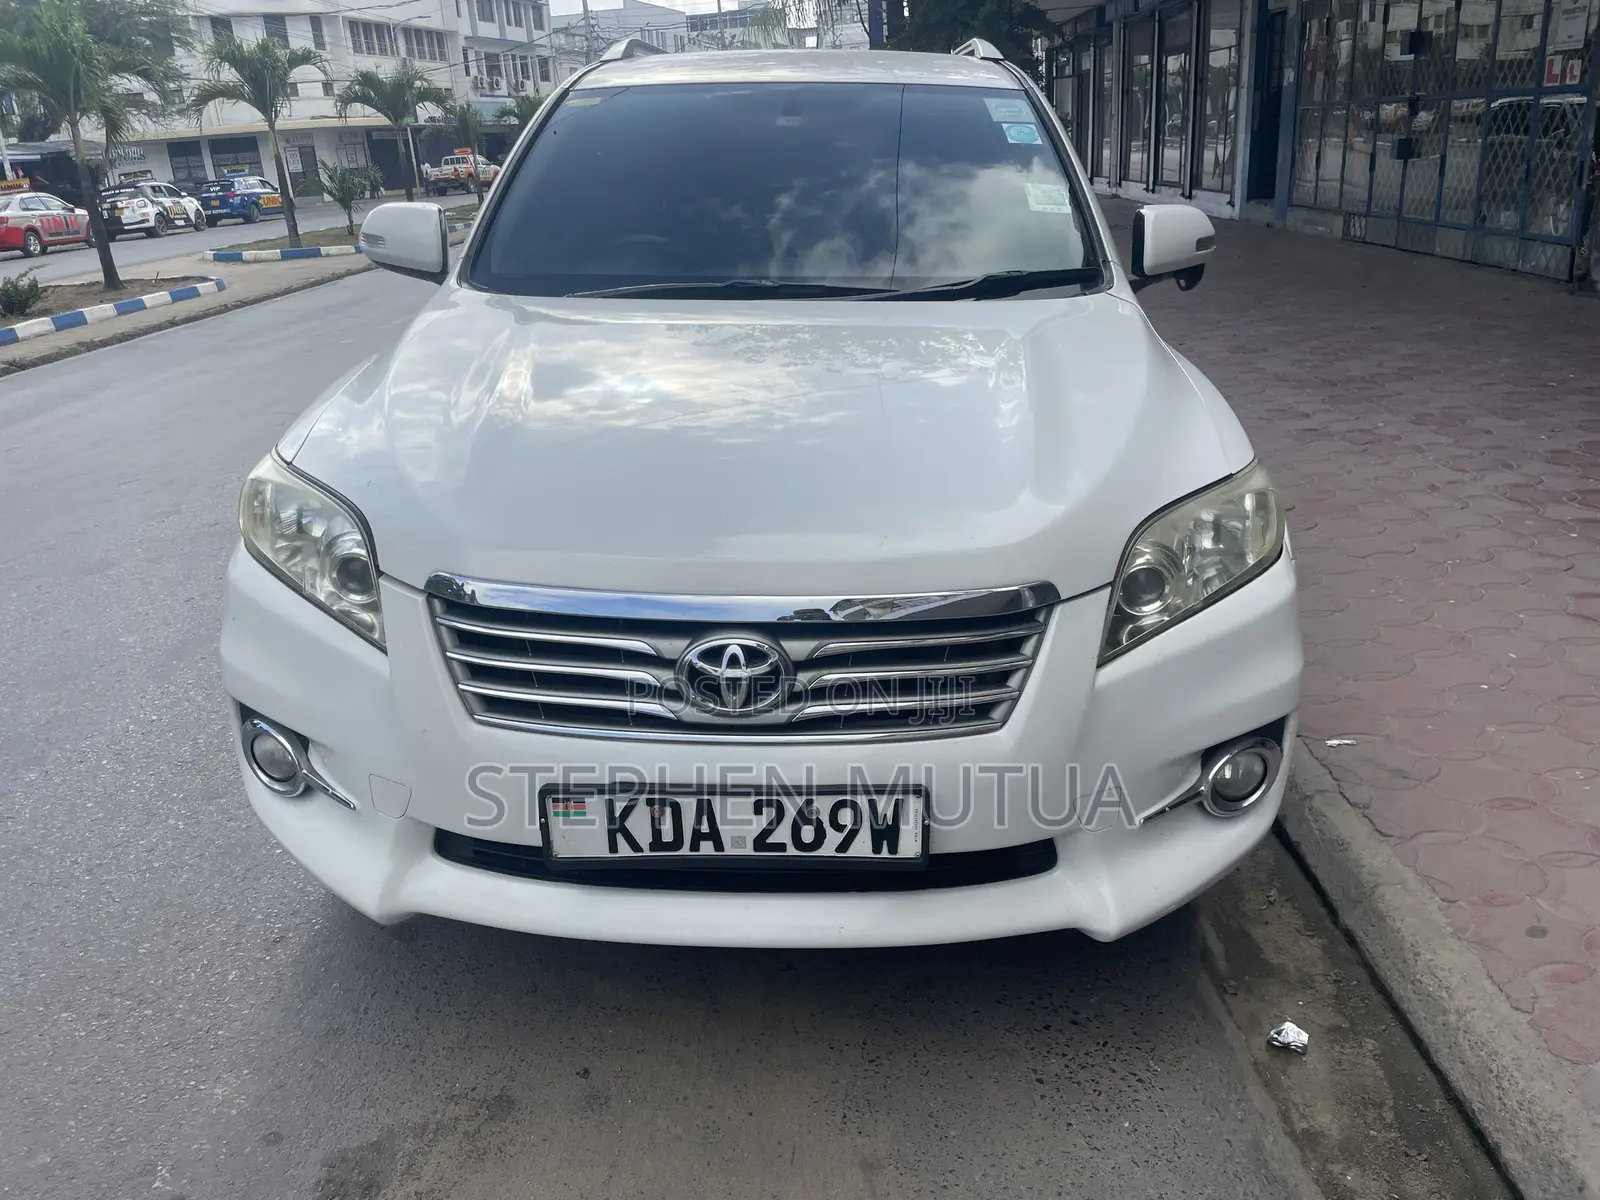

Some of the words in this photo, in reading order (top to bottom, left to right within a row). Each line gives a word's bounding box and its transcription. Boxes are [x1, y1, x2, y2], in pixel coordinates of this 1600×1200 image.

[40, 215, 82, 233] UNIK
[605, 797, 725, 854] KDA
[753, 797, 902, 855] 269W
